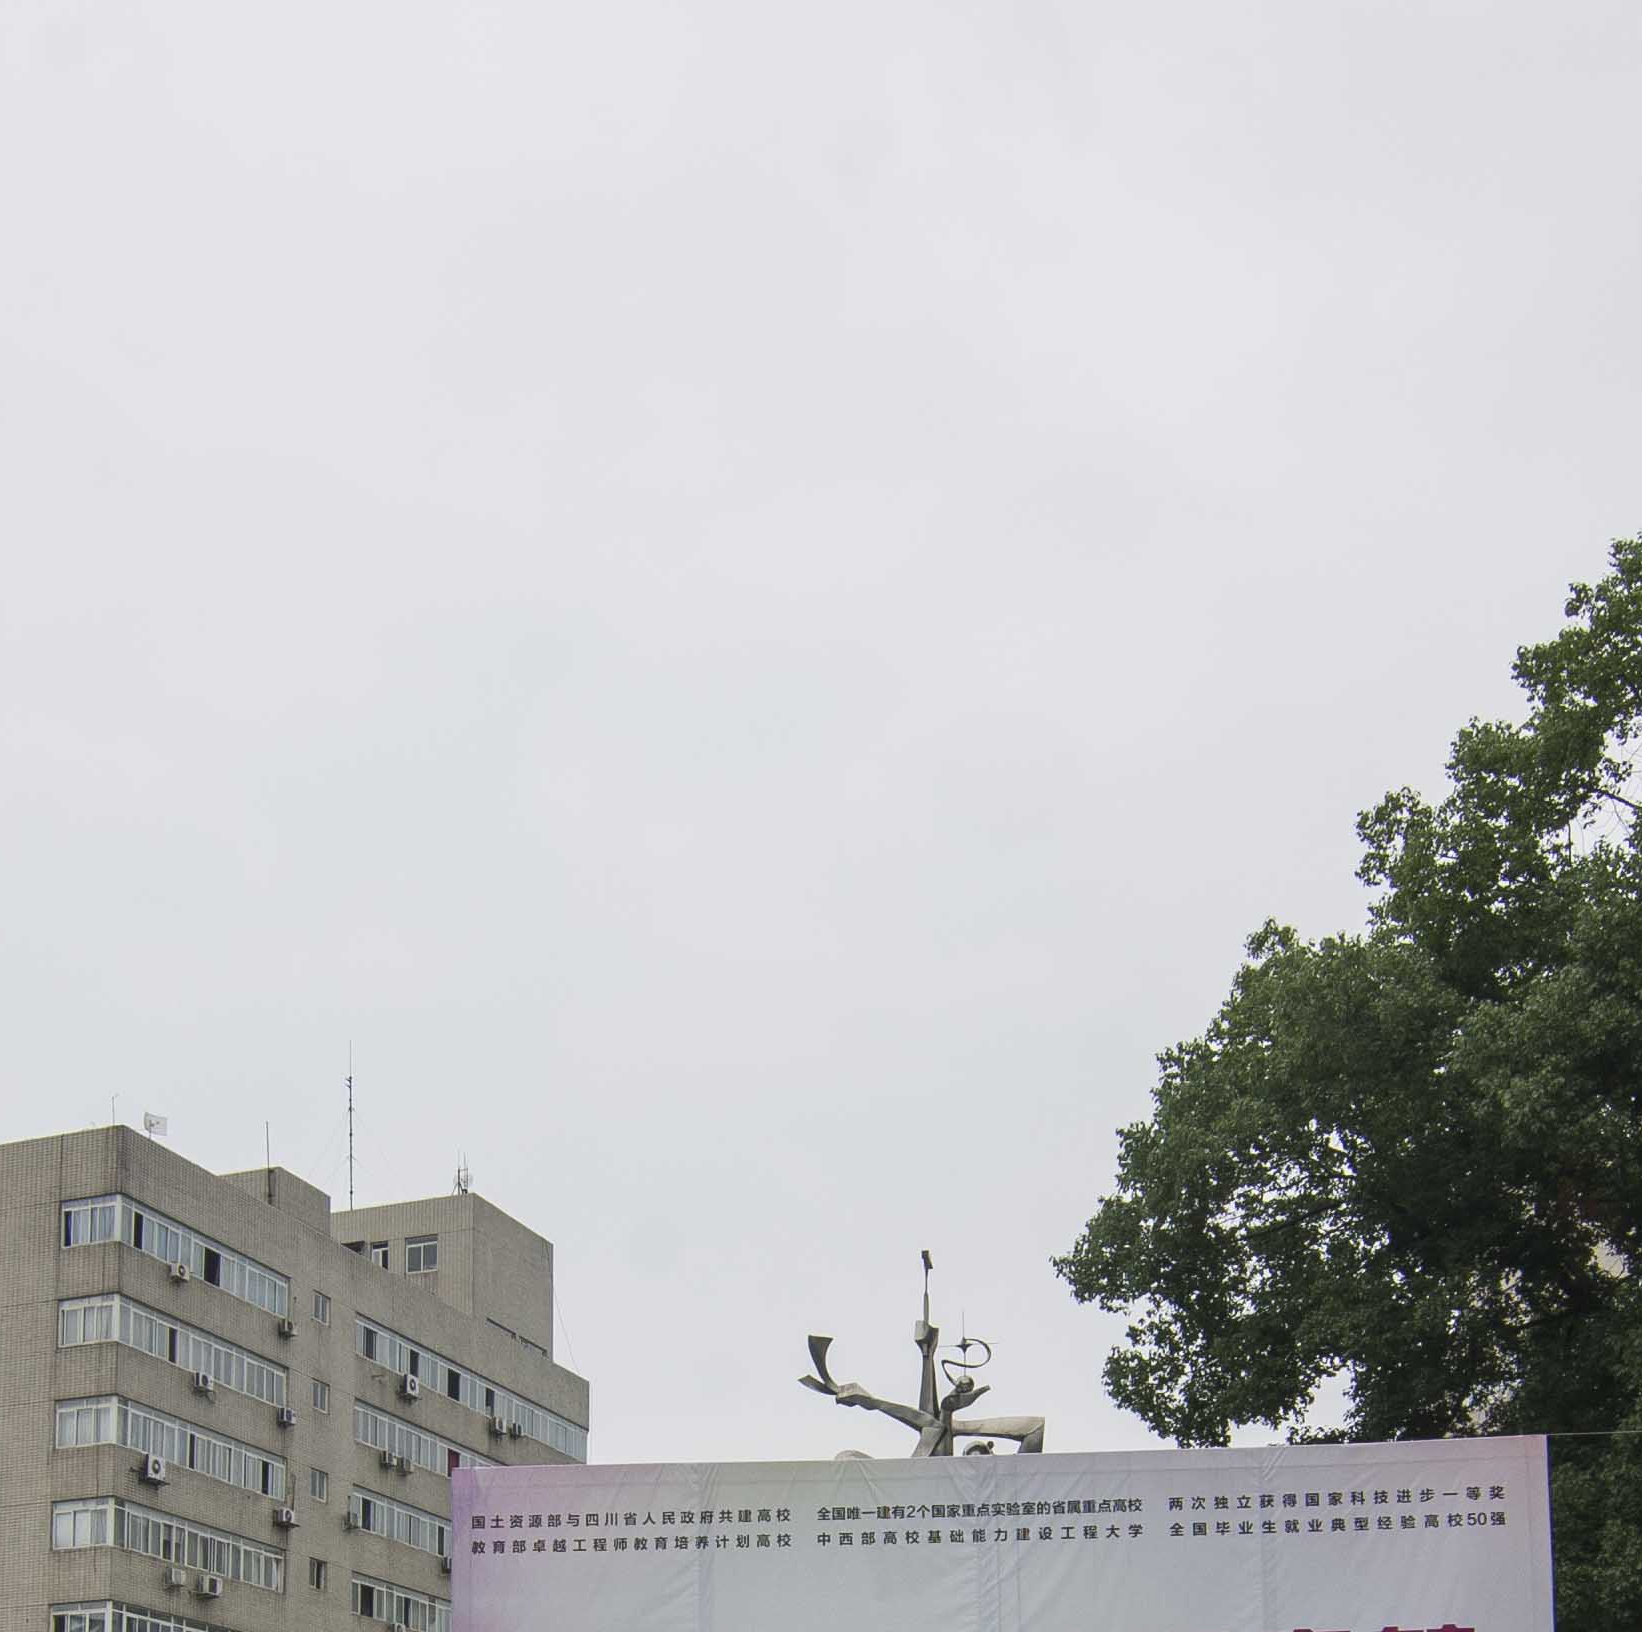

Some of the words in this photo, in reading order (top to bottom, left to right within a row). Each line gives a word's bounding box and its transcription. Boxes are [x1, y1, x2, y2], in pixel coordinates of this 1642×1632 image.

[817, 1497, 1143, 1521] 全国唯一建有2个国家重点实验室的省属重点高校
[1168, 1485, 1505, 1512] 两次独立获得国家科技进步一等奖
[472, 1507, 792, 1530] 国土资源部与四川省人民政府共建高校
[1169, 1511, 1507, 1537] 全国毕业生就业典型经验高校50强
[472, 1533, 792, 1555] 教育部卓越工程师教育培养计划高校
[817, 1524, 1144, 1547] 中西部高校基础能力建设工程大学
